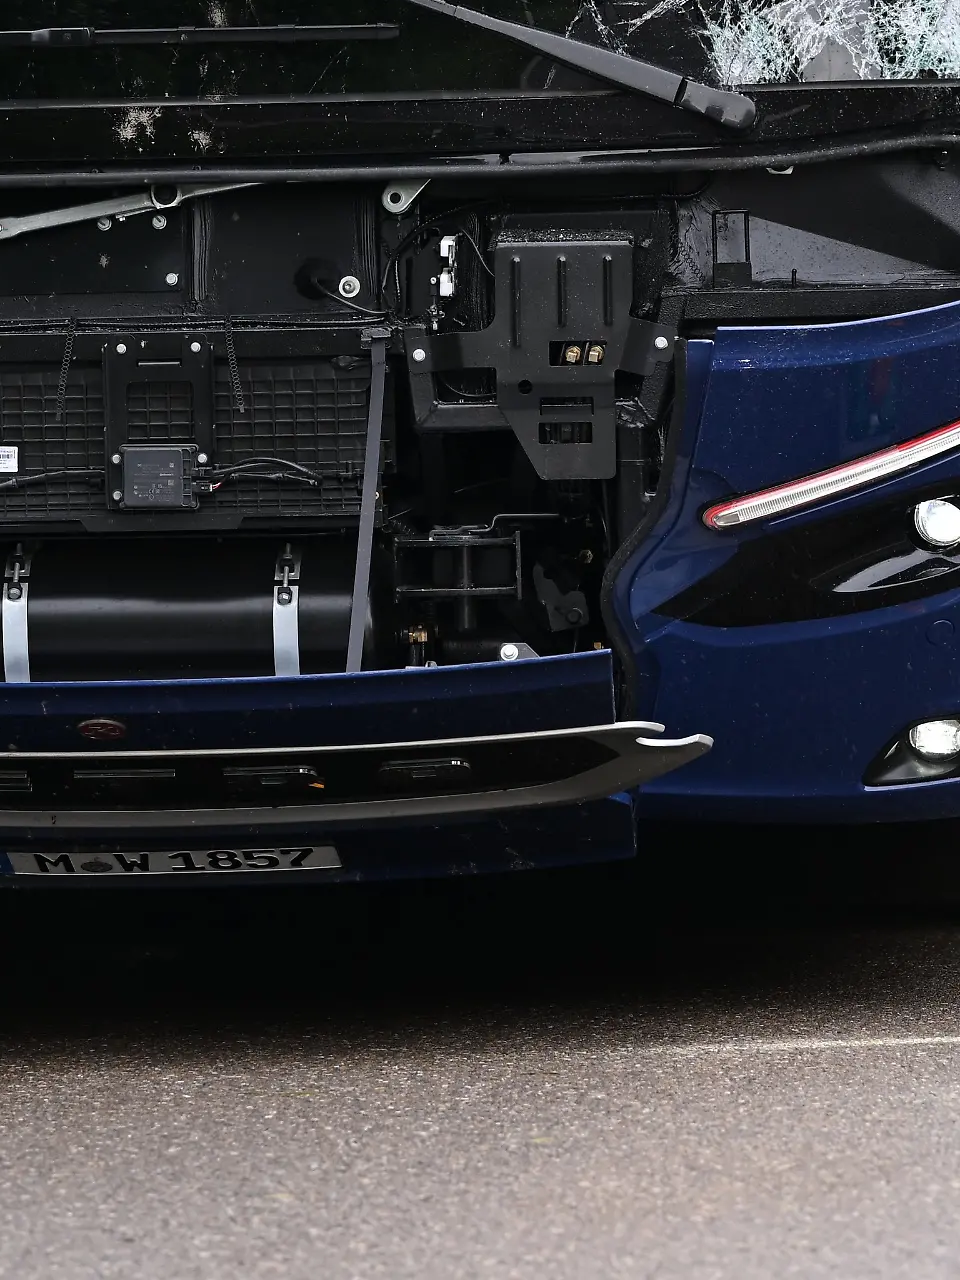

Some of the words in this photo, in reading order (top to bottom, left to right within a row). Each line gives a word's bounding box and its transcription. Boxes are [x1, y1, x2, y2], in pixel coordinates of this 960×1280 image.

[33, 852, 76, 873] M
[112, 851, 151, 872] W
[167, 847, 315, 871] 1857
